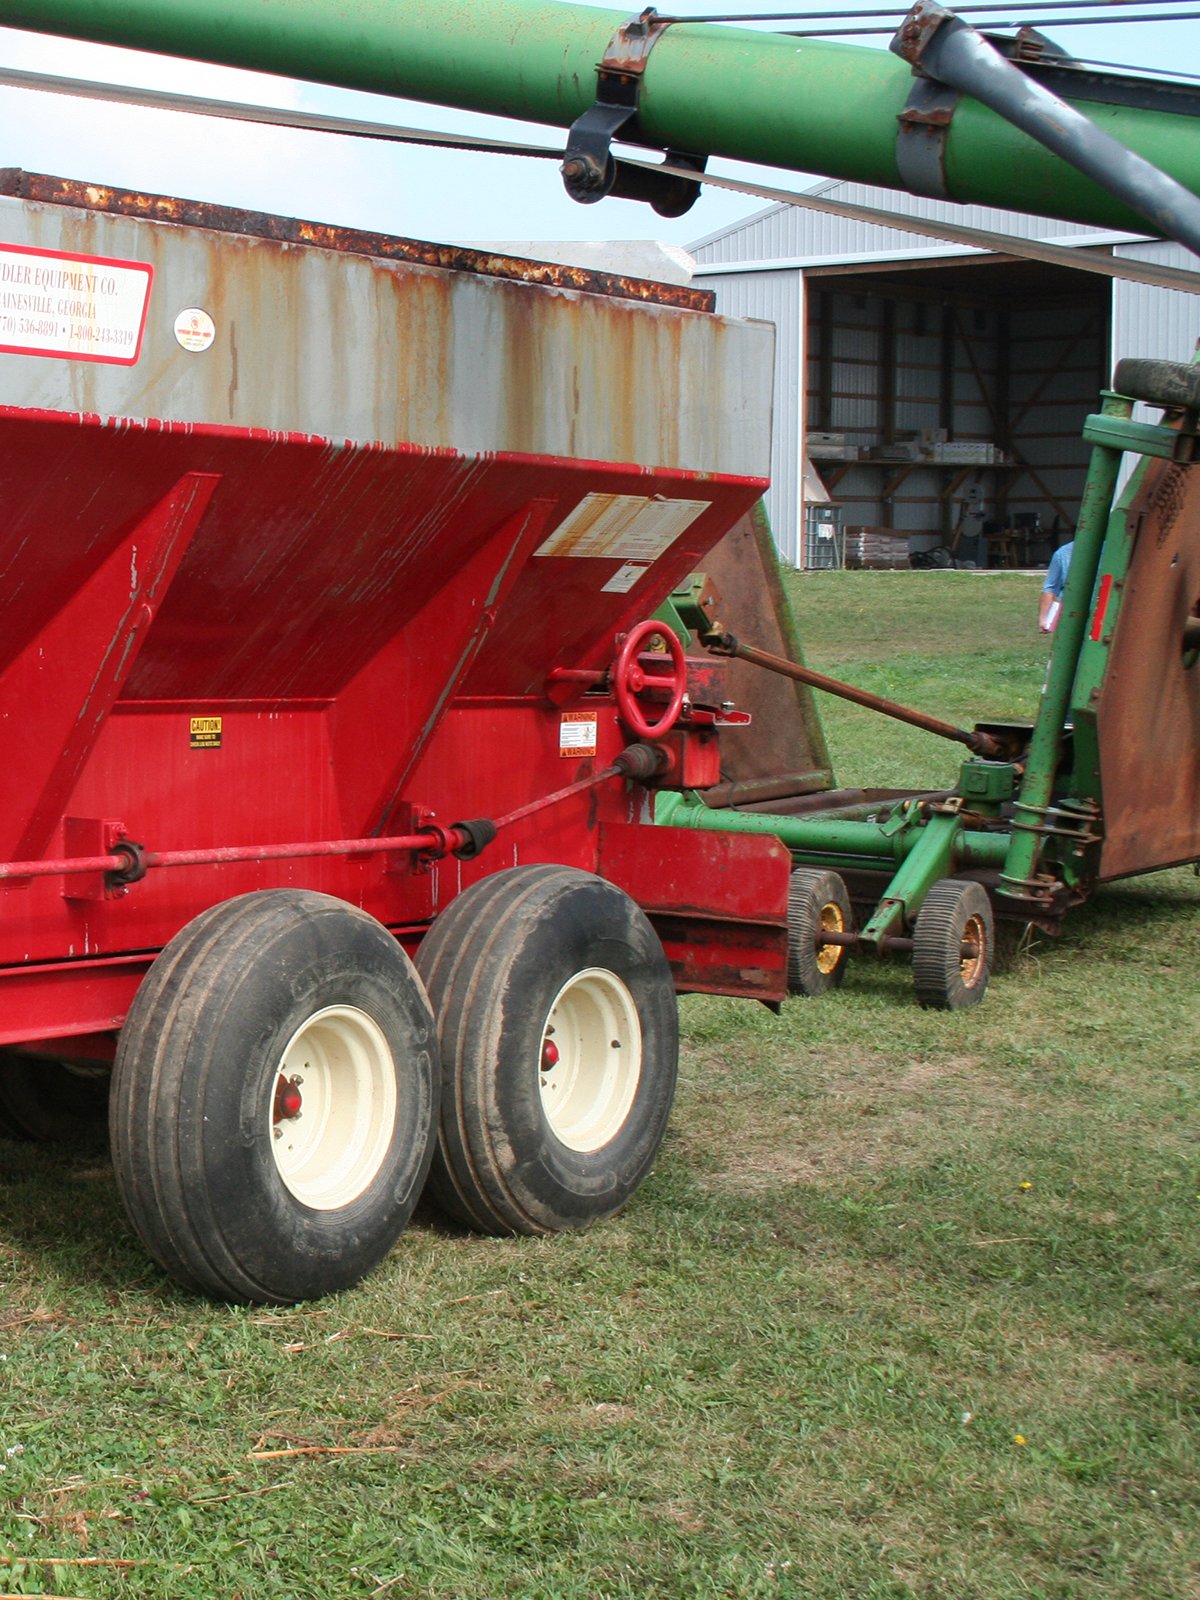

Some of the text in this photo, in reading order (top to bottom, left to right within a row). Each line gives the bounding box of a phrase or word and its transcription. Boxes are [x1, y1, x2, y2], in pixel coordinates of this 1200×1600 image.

[34, 267, 98, 293] EQUIPMENT
[101, 276, 118, 296] CO.
[58, 299, 96, 319] GEORGIA
[18, 317, 58, 337] 536-8891
[69, 323, 133, 345] 1-800-243-3319
[568, 712, 596, 722] WARNING
[191, 719, 220, 732] CAUTION!
[567, 747, 595, 756] WARNING
